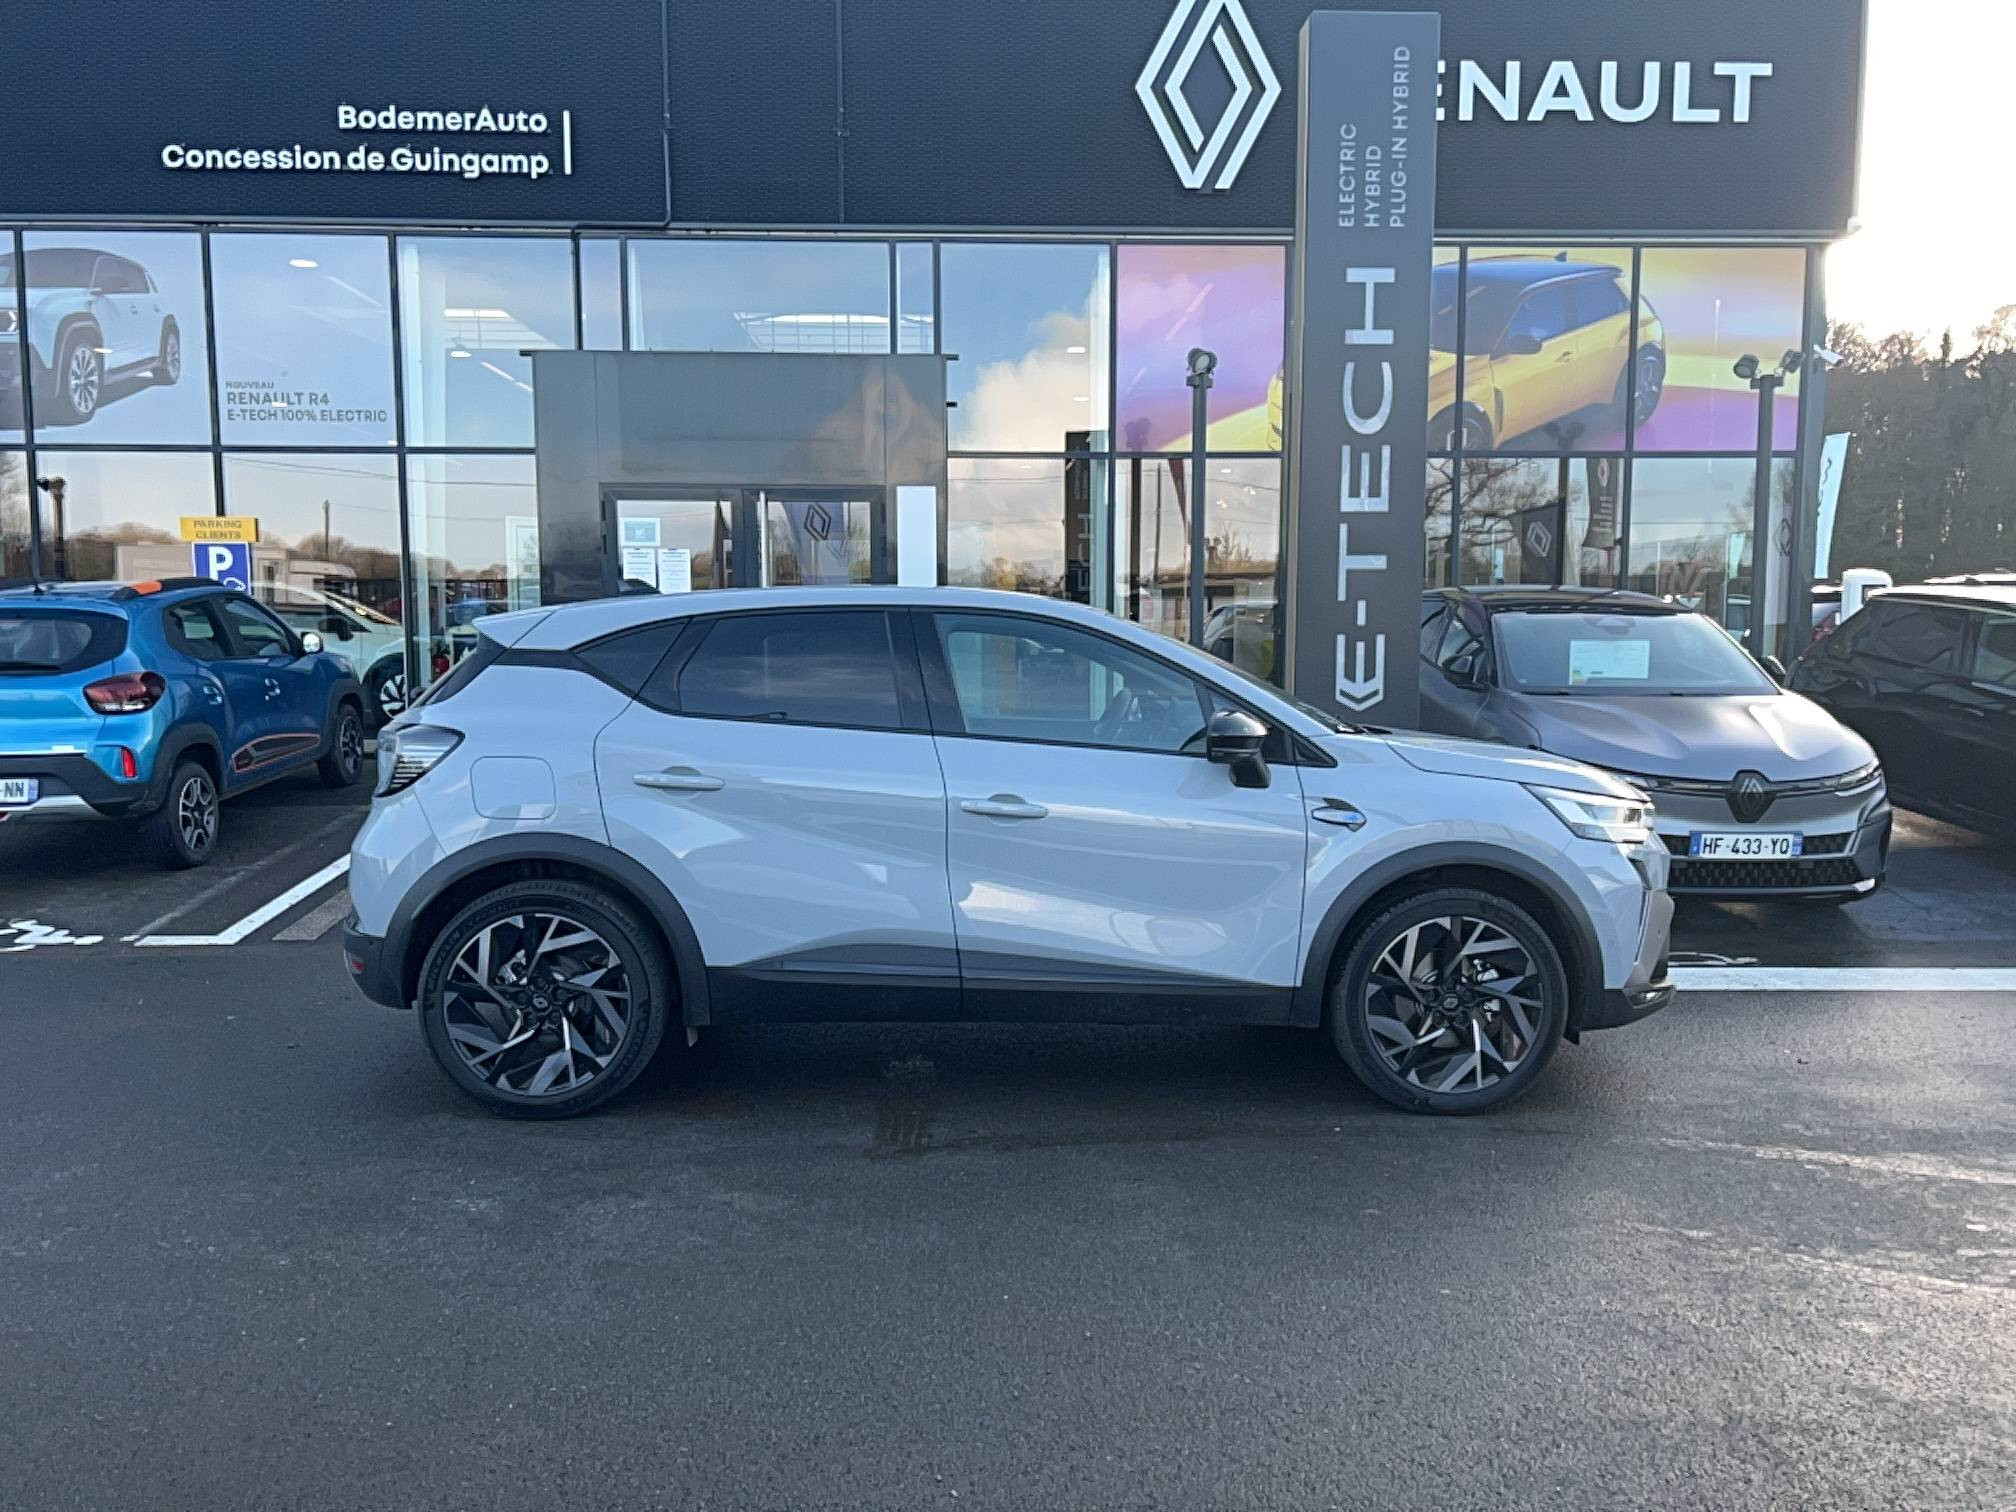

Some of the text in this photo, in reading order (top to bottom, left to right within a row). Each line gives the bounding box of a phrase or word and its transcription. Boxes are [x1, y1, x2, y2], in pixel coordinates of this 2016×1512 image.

[1436, 60, 1774, 123] NAULT
[337, 104, 549, 133] BodemerAuto
[1389, 45, 1411, 228] PLUG-IN HYBRID
[161, 143, 549, 179] Concession de Guingamp
[1338, 122, 1358, 228] ELECTRIC
[1363, 144, 1383, 228] HYBRID
[225, 381, 275, 390] NOUVEAU
[226, 392, 330, 406] RENAULT R4
[226, 409, 388, 422] E-TECH 100% ELECTRIC
[1335, 266, 1397, 712] E-TECH
[193, 520, 243, 529] PARKING
[195, 530, 242, 539] CLIENTS
[208, 546, 234, 581] P
